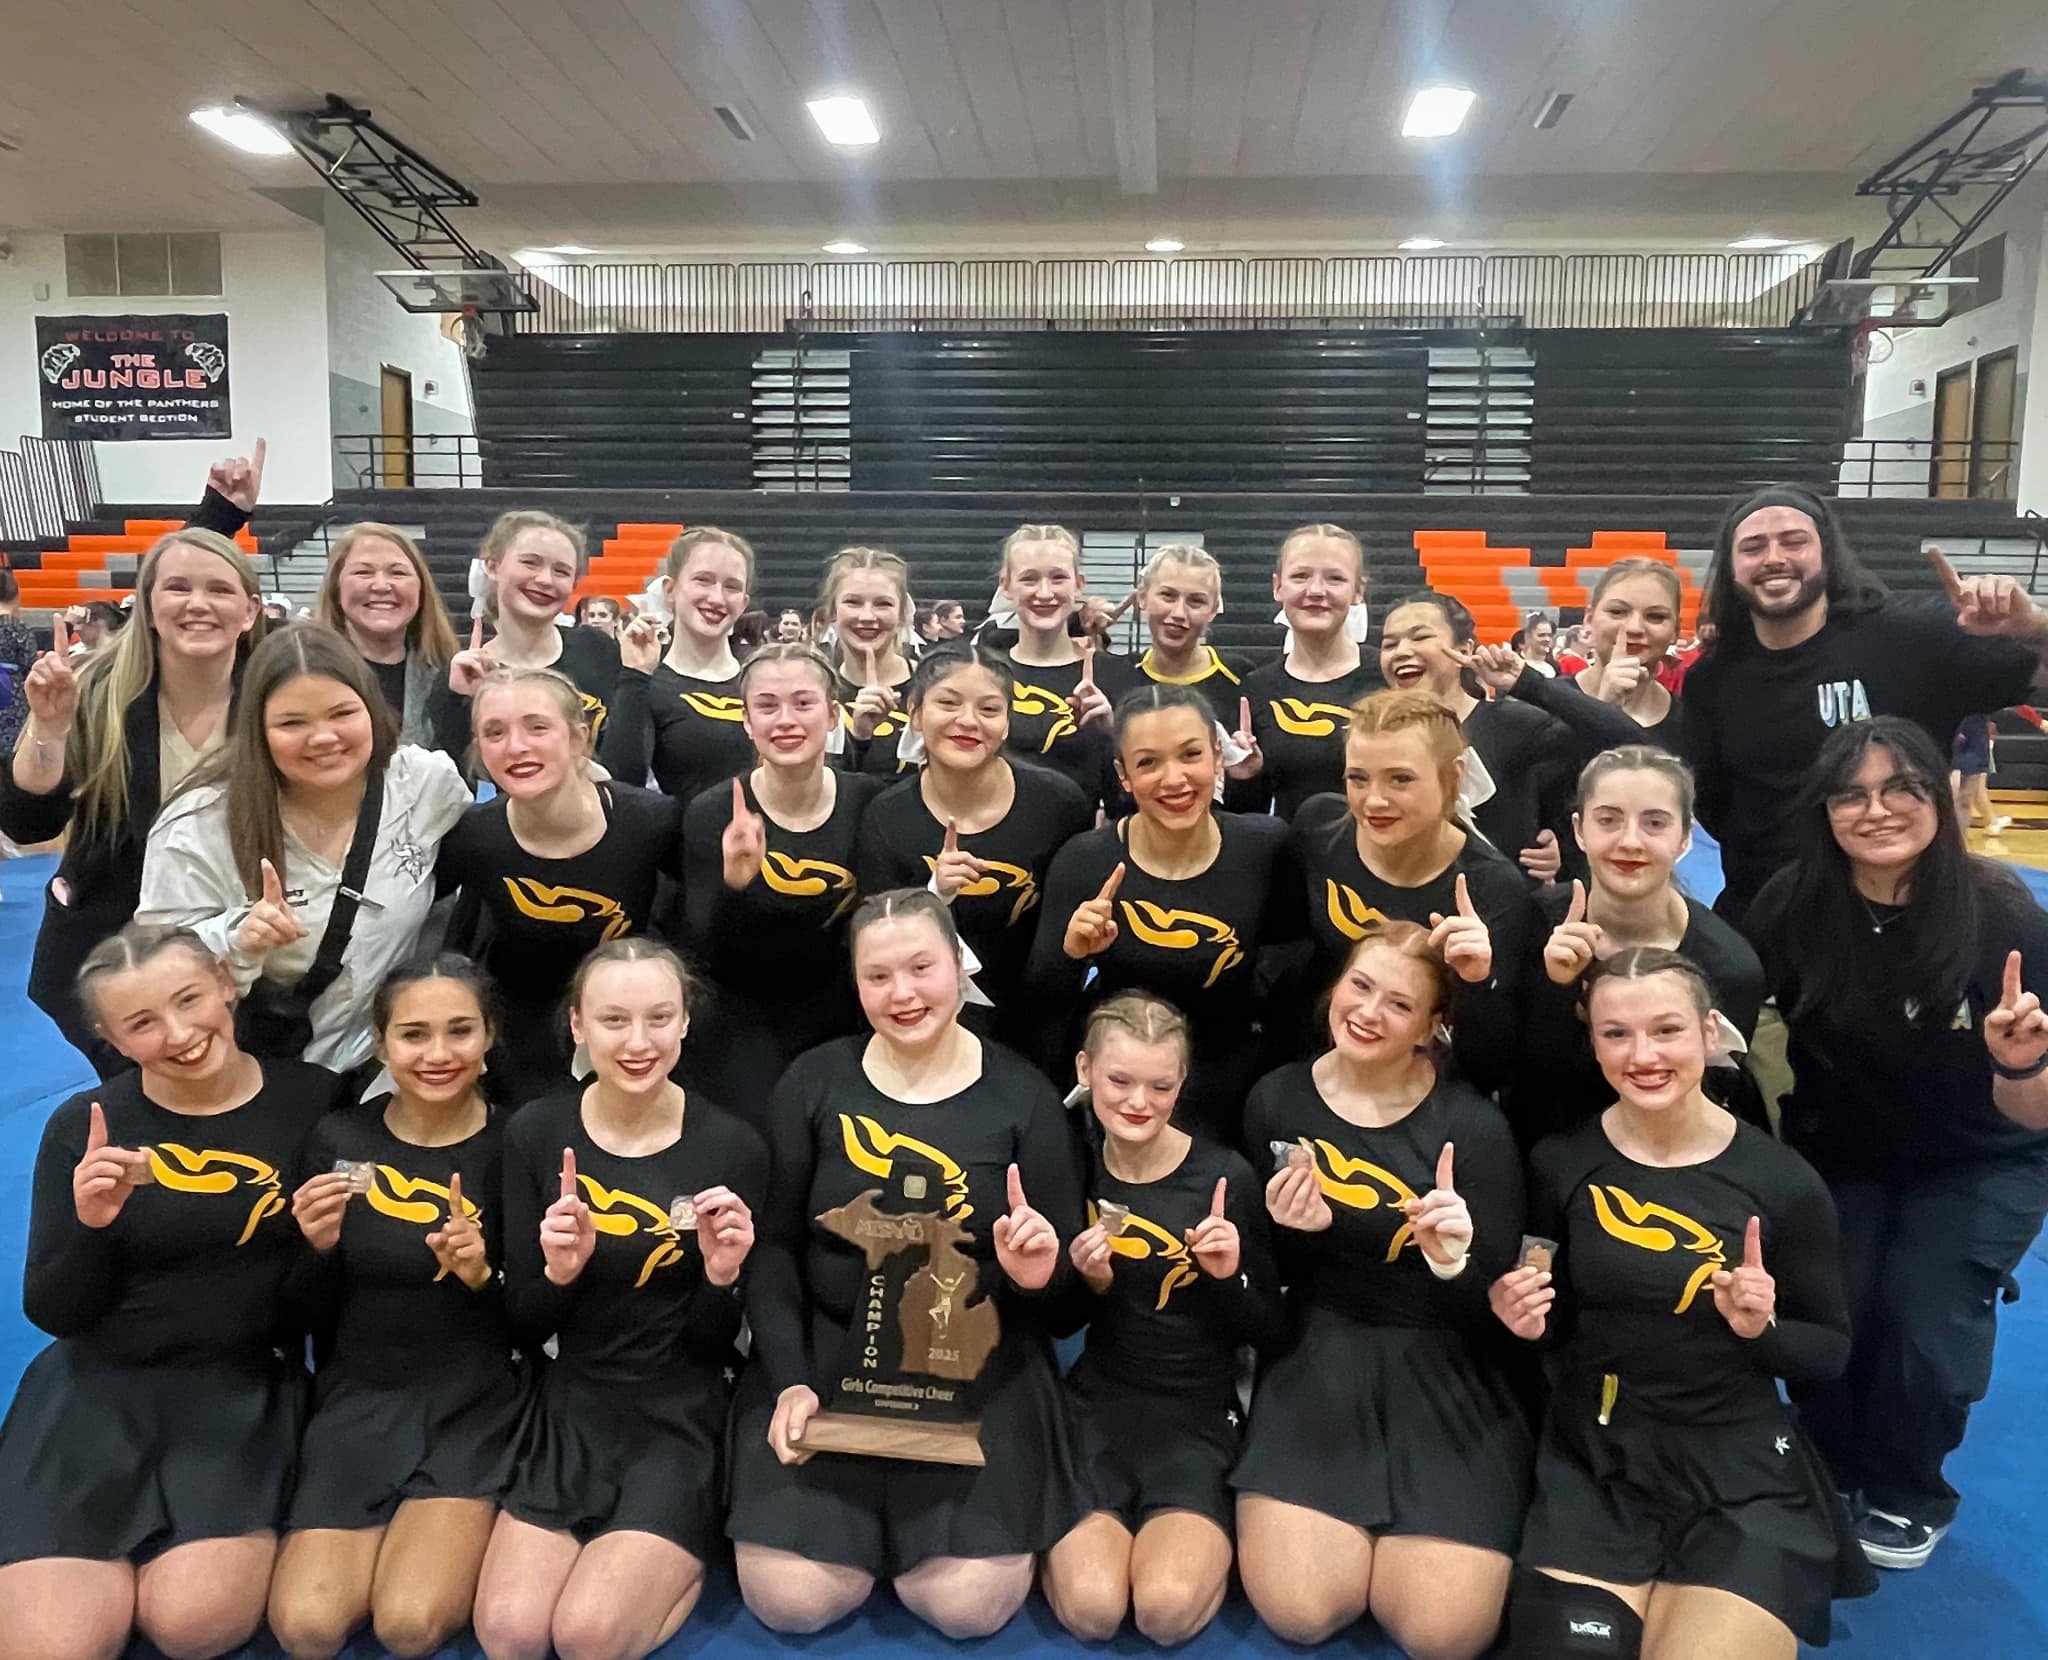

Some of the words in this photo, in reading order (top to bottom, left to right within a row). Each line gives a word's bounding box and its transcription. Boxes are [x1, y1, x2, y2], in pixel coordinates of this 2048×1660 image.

[64, 330, 162, 342] WELCOME
[110, 354, 156, 368] THE
[61, 369, 208, 389] JUNGLE
[52, 400, 91, 409] HOME
[94, 400, 113, 409] OF
[117, 400, 144, 408] THE
[147, 399, 219, 409] PANTHERS
[74, 414, 135, 423] STUDENT
[139, 414, 198, 423] SECTION
[1817, 679, 1873, 728] UTA
[863, 1275, 885, 1368] CHAMPION
